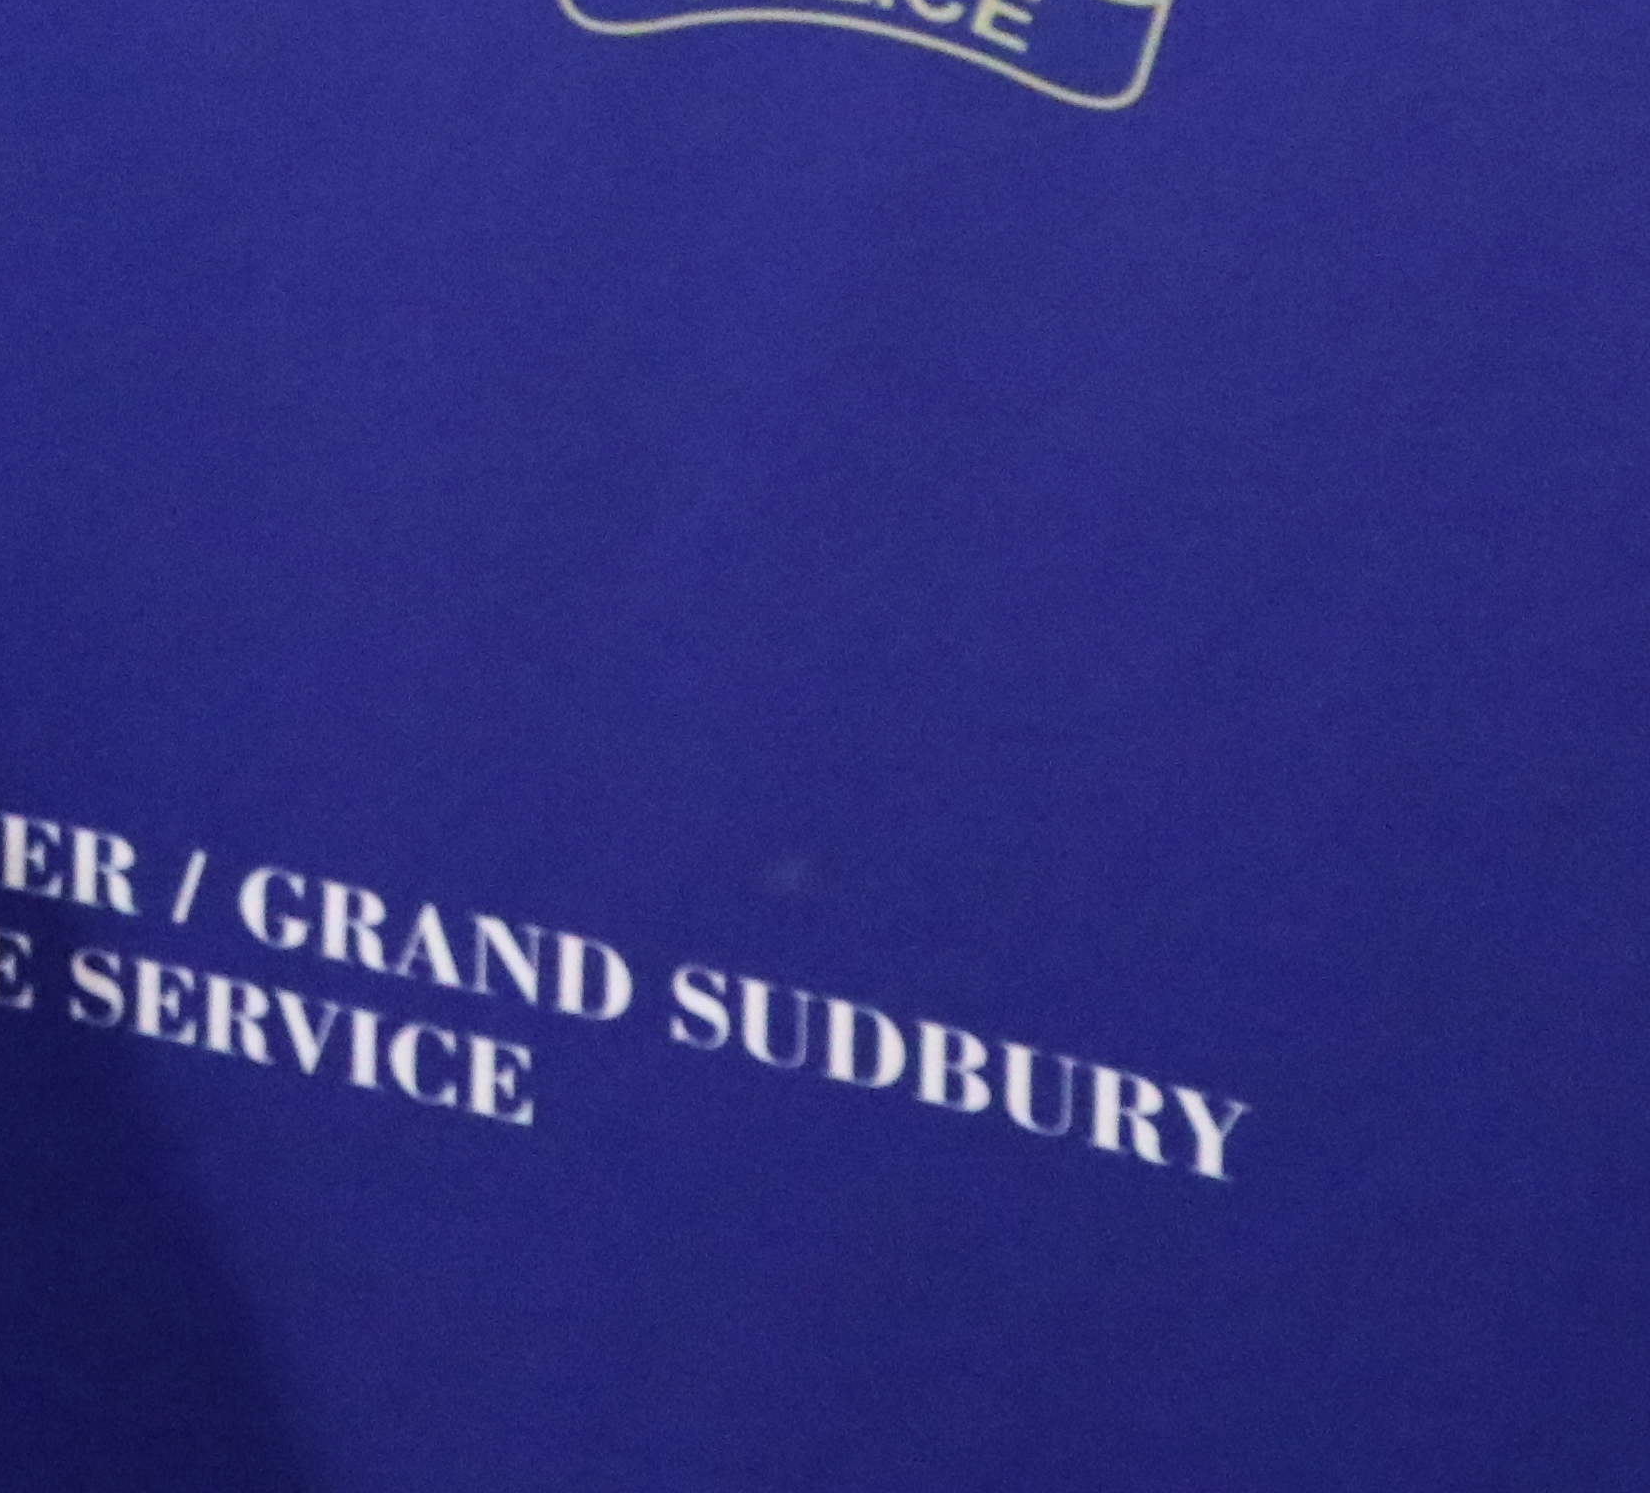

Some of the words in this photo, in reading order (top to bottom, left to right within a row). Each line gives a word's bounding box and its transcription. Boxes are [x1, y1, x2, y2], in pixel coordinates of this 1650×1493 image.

[69, 946, 539, 1127] SERVICE
[172, 849, 207, 924] /
[239, 868, 632, 1021] GRAND
[671, 967, 1245, 1180] SUDBURY
